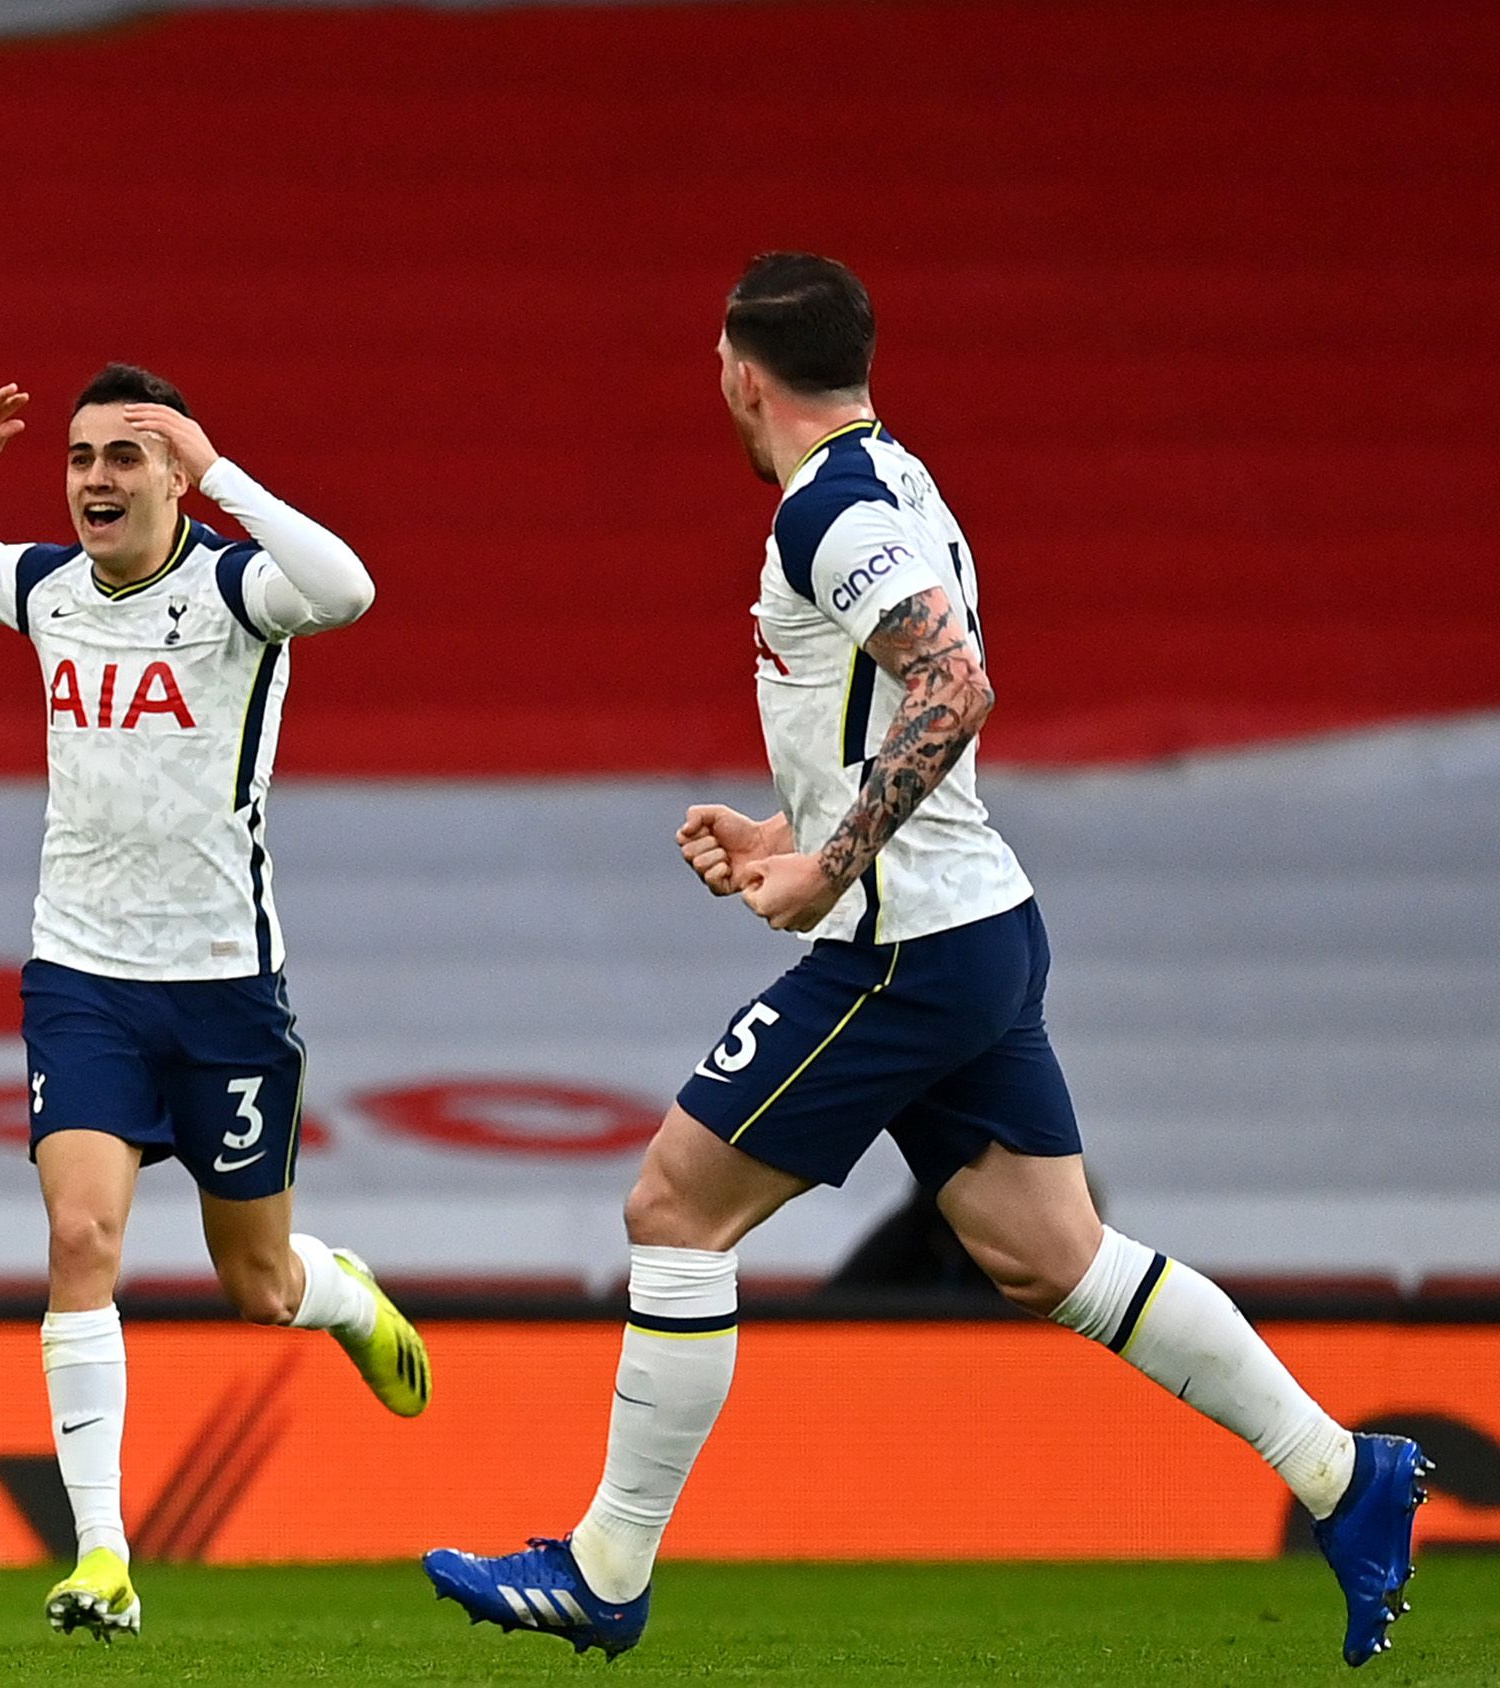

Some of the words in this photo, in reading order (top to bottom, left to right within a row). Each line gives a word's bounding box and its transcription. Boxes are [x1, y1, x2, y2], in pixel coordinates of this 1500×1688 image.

[832, 545, 914, 612] cinch
[50, 659, 196, 729] AIA
[713, 1001, 781, 1072] 5
[222, 1076, 264, 1149] 3
